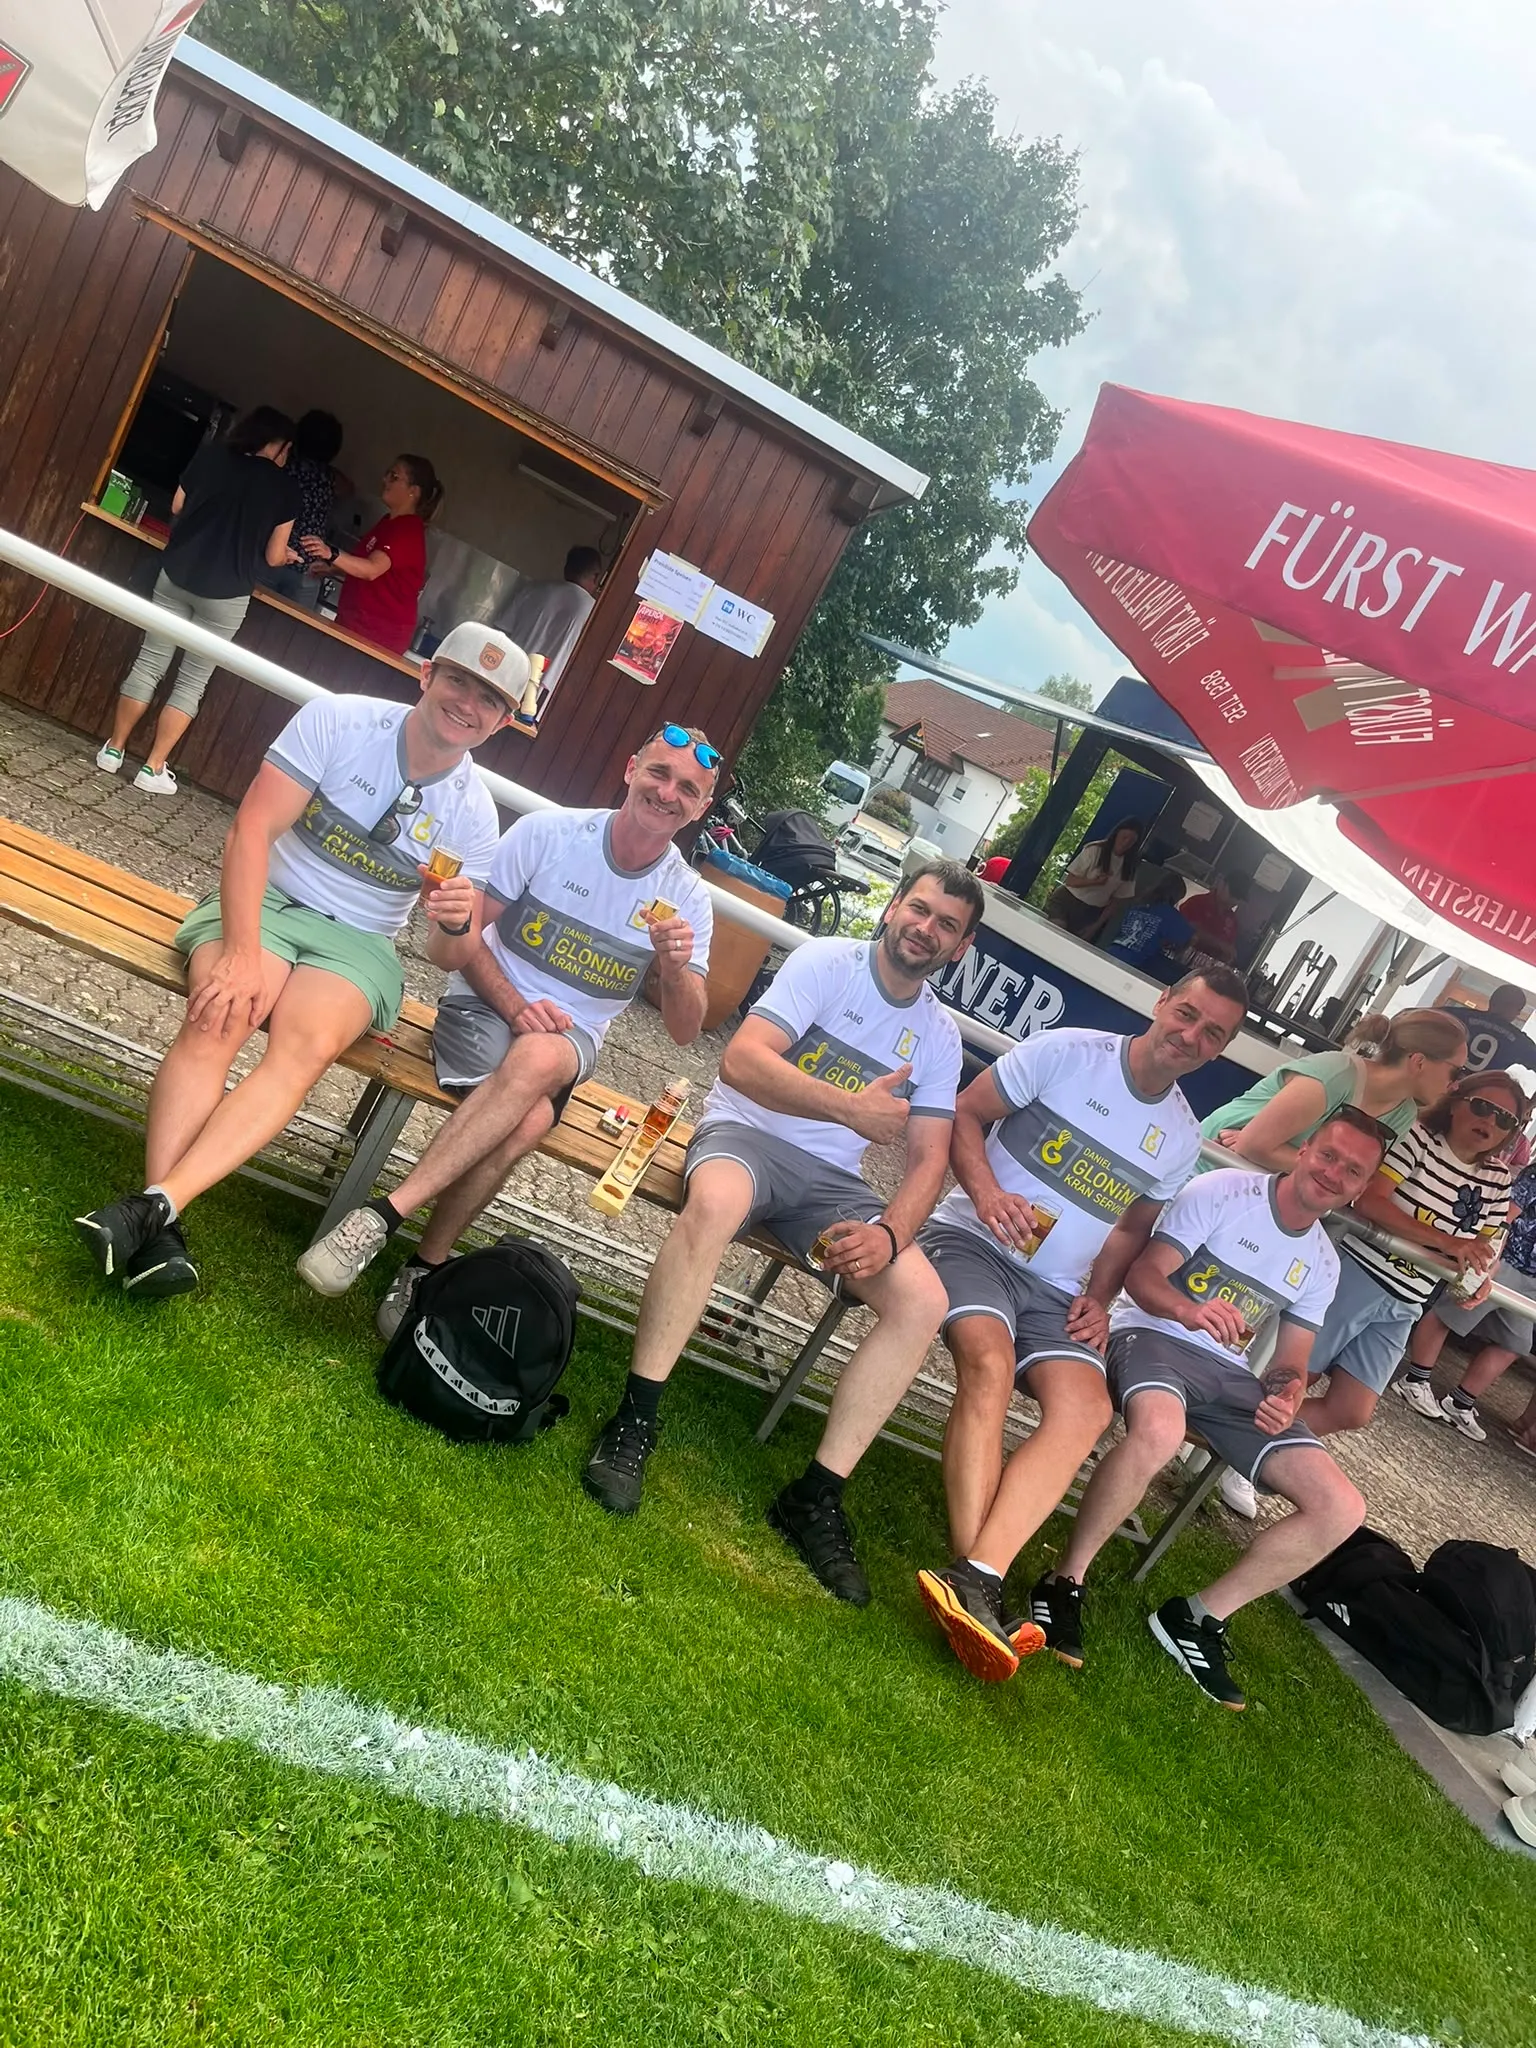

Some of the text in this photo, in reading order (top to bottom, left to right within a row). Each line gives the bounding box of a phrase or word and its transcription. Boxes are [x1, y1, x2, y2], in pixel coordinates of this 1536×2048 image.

[1244, 500, 1465, 632] FÜRST
[736, 607, 757, 626] WC
[349, 774, 377, 797] JAKO
[334, 824, 370, 851] DANIEL
[562, 880, 590, 898] JAKO
[562, 926, 593, 947] DANIEL
[548, 953, 629, 992] KRAN SERVICE
[843, 1008, 864, 1025] JAKO
[1463, 1033, 1499, 1072] 9
[836, 1056, 863, 1074] DANIEL
[1085, 1098, 1110, 1117] JAKO
[1083, 1147, 1113, 1171] DANIEL
[1063, 1174, 1126, 1216] KRAN SERVIC
[1237, 1237, 1260, 1254] JAKO
